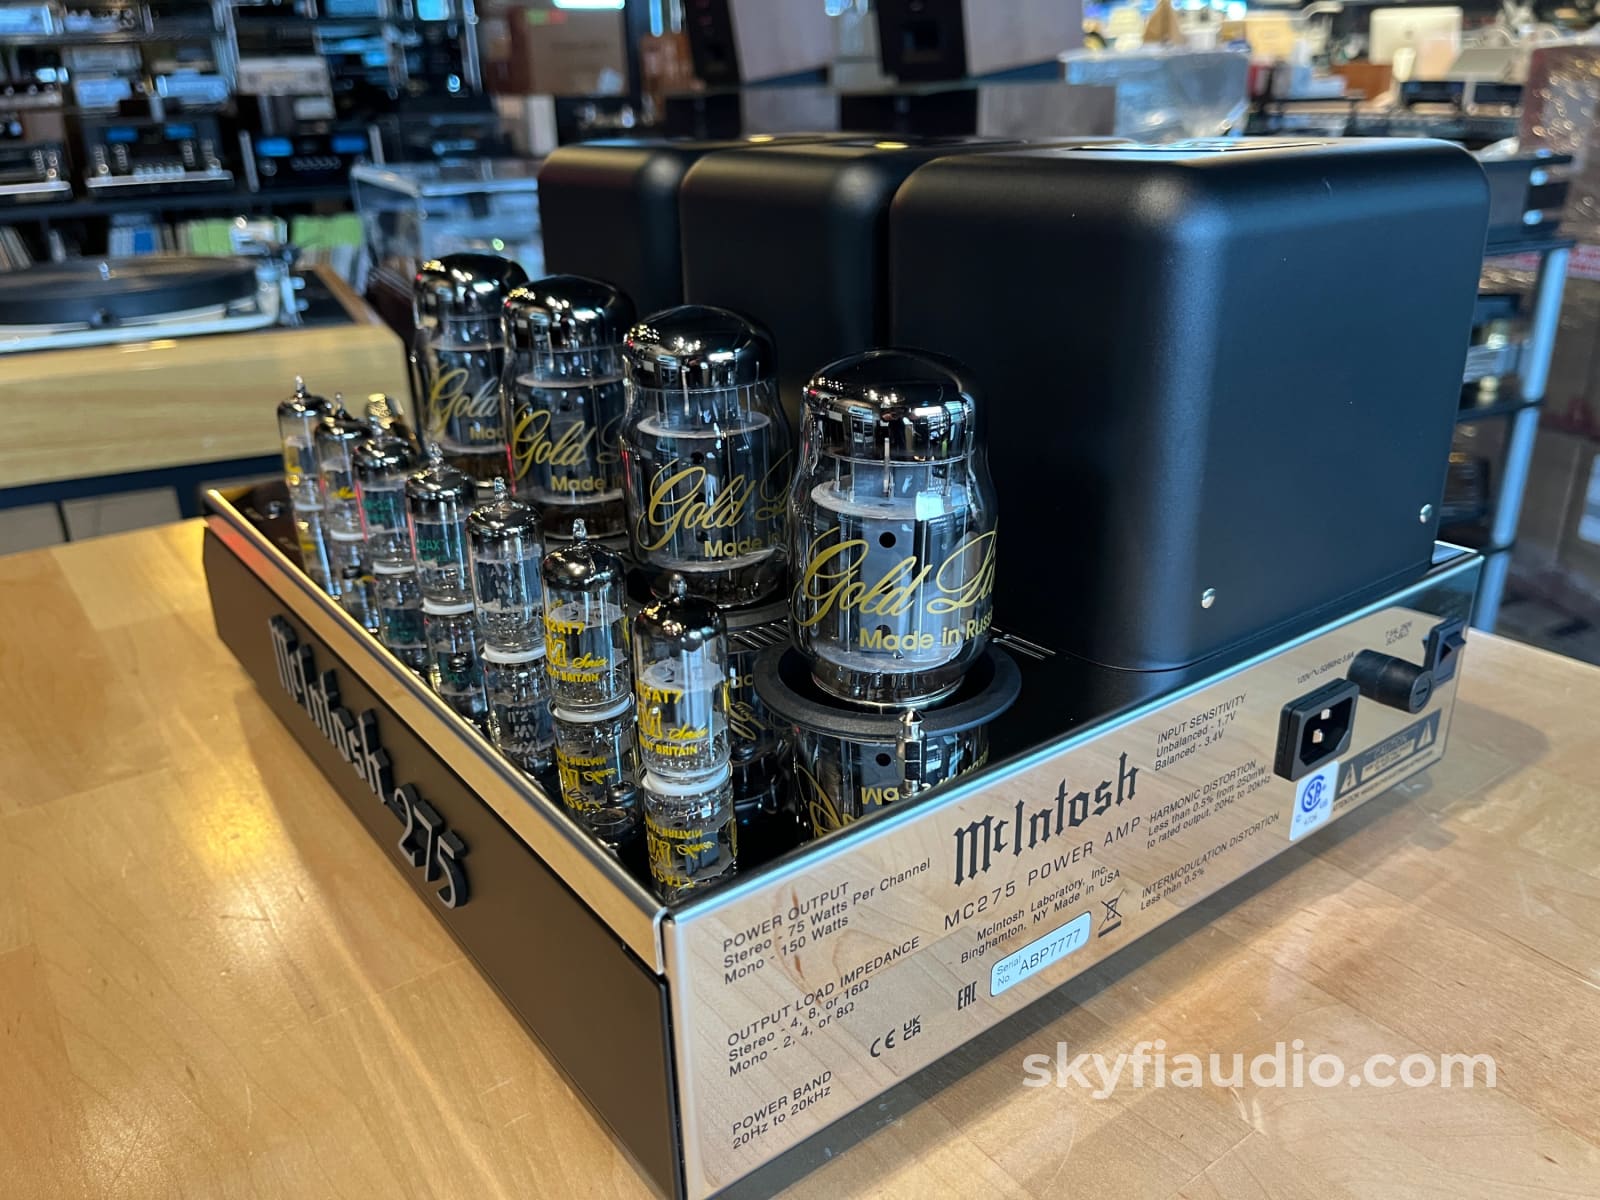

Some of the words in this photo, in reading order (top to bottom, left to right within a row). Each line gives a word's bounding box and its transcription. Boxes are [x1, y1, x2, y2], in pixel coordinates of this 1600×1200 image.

[513, 403, 597, 481] Gold
[551, 475, 606, 492] Made
[637, 458, 757, 550] Gold
[704, 537, 763, 558] Made
[792, 527, 934, 627] Gold
[859, 627, 934, 651] Made
[942, 627, 960, 647] in
[656, 743, 698, 756] BRITAIN
[1155, 745, 1196, 771] Balanced
[1204, 729, 1225, 747] 3.4V
[1156, 726, 1208, 757] Unbalanced
[1217, 711, 1237, 729] 1.7V
[1157, 721, 1187, 744] INPUT
[1190, 693, 1247, 729] SENSITIVITY
[953, 752, 1140, 887] McIntosh
[1146, 837, 1156, 849] to
[1159, 825, 1182, 844] rated
[1182, 808, 1212, 832] output,
[1214, 795, 1235, 813] 20Hz
[1236, 789, 1246, 800] to
[1247, 775, 1271, 794] 20kHz
[1148, 819, 1169, 836] Less
[1172, 810, 1191, 826] than
[1192, 794, 1214, 812] 0.5%
[1216, 783, 1235, 801] from
[1236, 765, 1266, 789] 250mW
[1150, 788, 1201, 822] HARMONIC
[1203, 759, 1257, 796] DISTORTION
[394, 783, 470, 909] 275
[944, 880, 1016, 930] MC275
[1028, 840, 1093, 886] POWER
[1103, 816, 1141, 847] AMP
[1142, 841, 1228, 898] INTERMODULATION
[1229, 811, 1280, 848] DISTORTION
[723, 915, 783, 952] POWER
[788, 881, 850, 921] OUTPUT
[724, 937, 772, 968] Stereo
[788, 921, 805, 938] 75
[810, 901, 847, 926] Watts
[852, 886, 875, 905] Per
[880, 857, 931, 892] Channel
[961, 923, 1027, 964] Binghamton,
[1032, 909, 1048, 924] NY
[1053, 893, 1080, 912] Made
[1085, 883, 1094, 894] in
[1100, 869, 1120, 887] USA
[977, 909, 1025, 941] McIntosh
[1030, 878, 1085, 913] Laboratory,
[1091, 866, 1108, 880] Inc.
[1140, 893, 1161, 911] Less
[1163, 882, 1182, 897] than
[1183, 867, 1205, 886] 0.5%
[724, 958, 764, 985] Mono
[781, 935, 807, 956] 150
[811, 917, 849, 942] Watts
[1019, 928, 1081, 975] ABP7777
[727, 1004, 791, 1047] OUTPUT
[796, 982, 835, 1012] LOAD
[840, 936, 920, 988] IMPEDANCE
[728, 1031, 775, 1062] Stereo
[825, 996, 839, 1010] or
[844, 979, 869, 1000] 16Ω
[903, 1015, 921, 1031] UK
[729, 1050, 768, 1077] Mono
[818, 1015, 832, 1029] or
[836, 1001, 855, 1018] 8Ω
[870, 1029, 896, 1058] CE
[903, 1027, 921, 1041] CA
[732, 1096, 788, 1135] POWER
[793, 1070, 832, 1100] BAND
[732, 1124, 768, 1149] 20Hz
[773, 1114, 786, 1127] to
[791, 1086, 831, 1117] 20kHz
